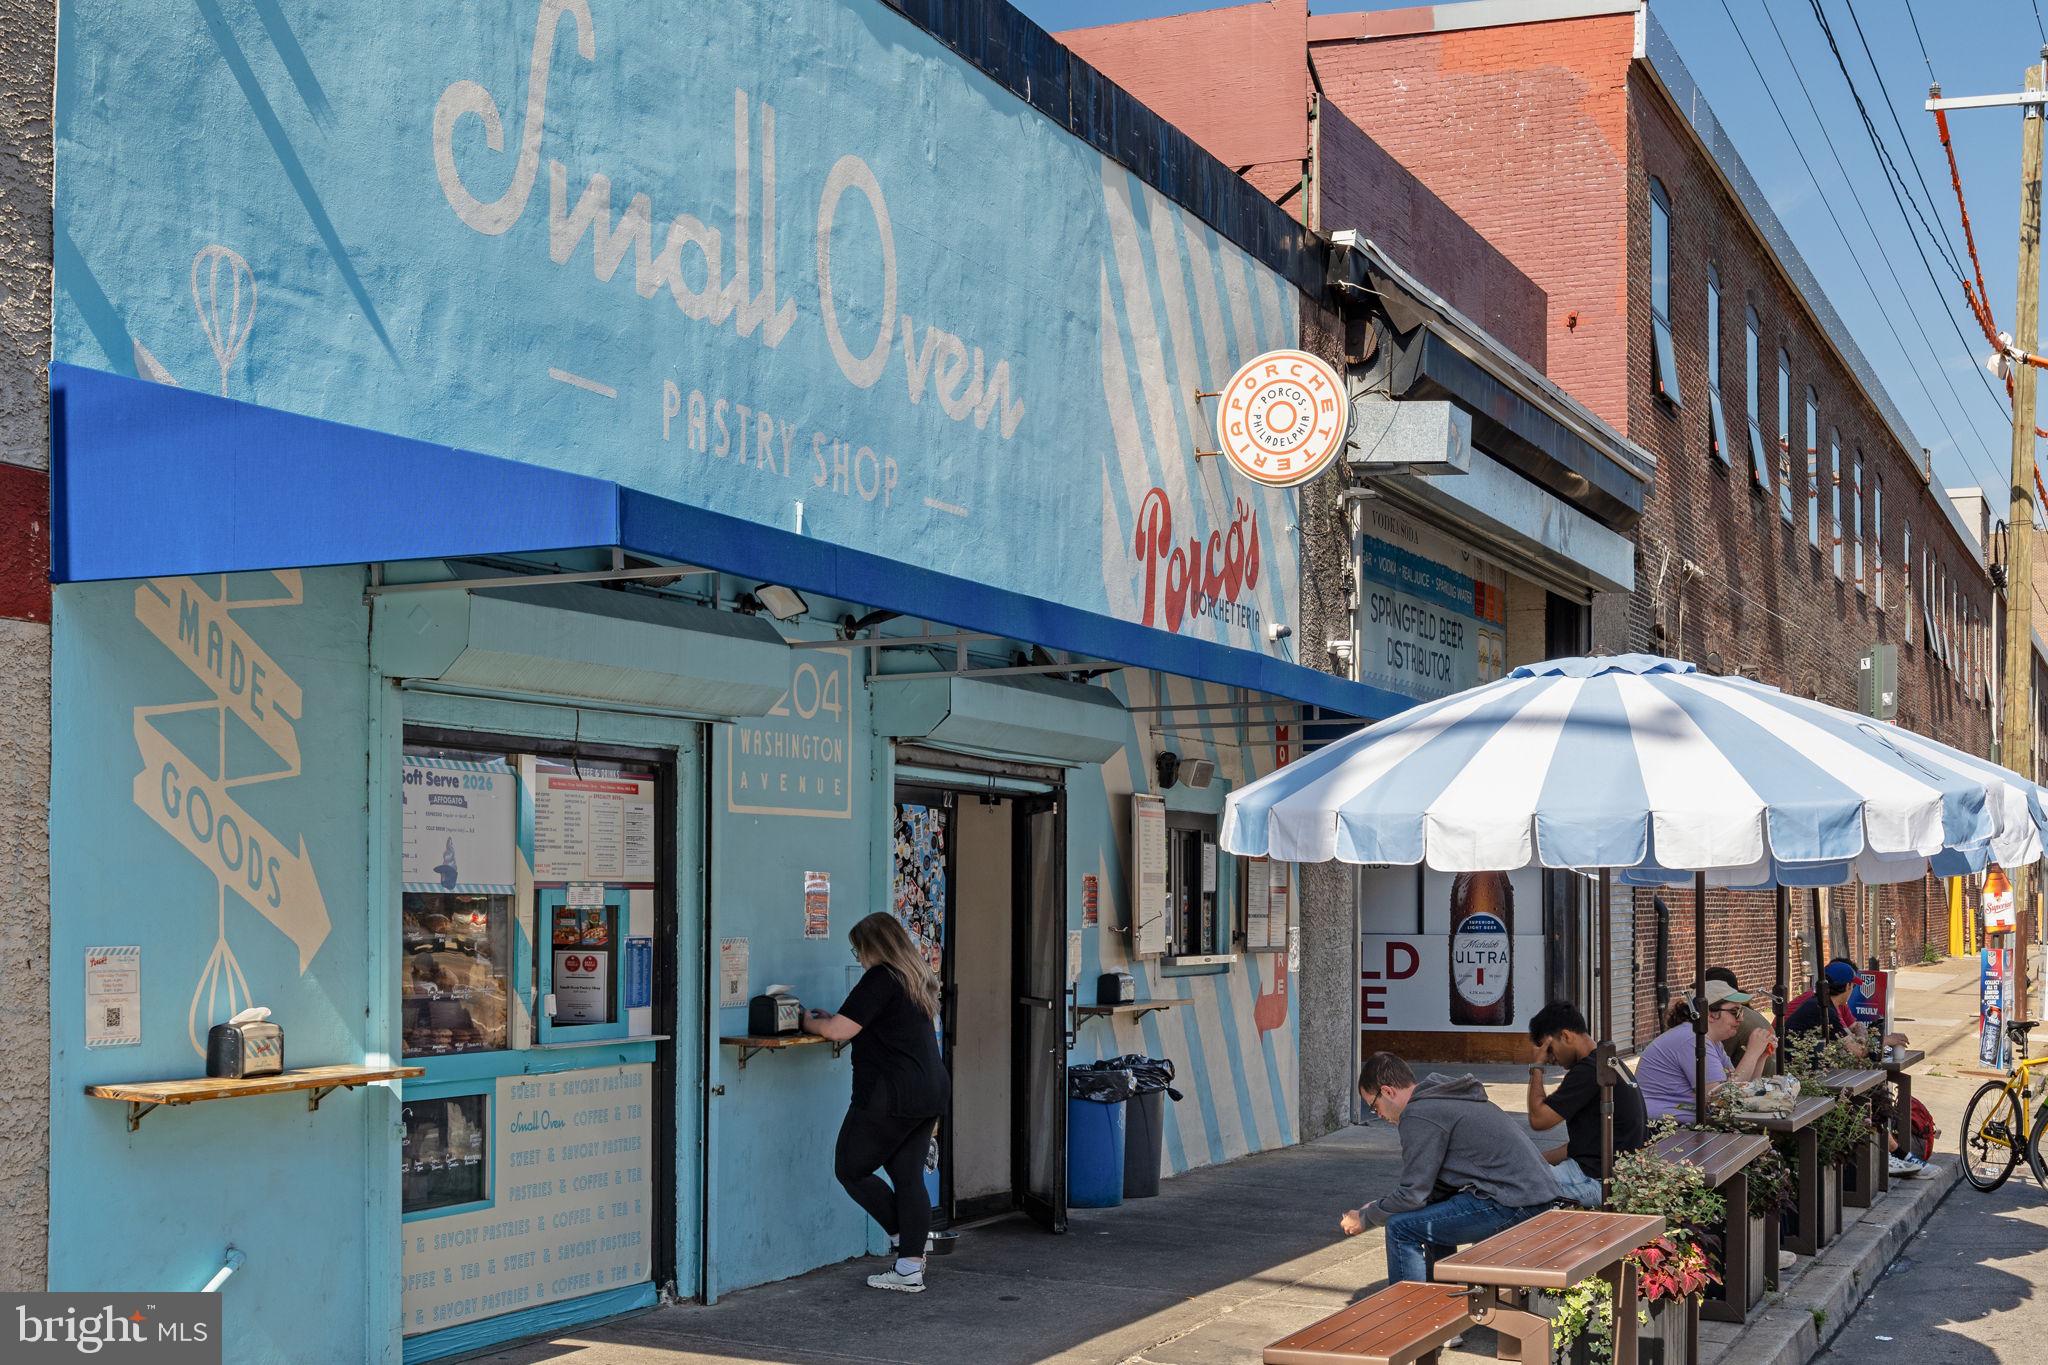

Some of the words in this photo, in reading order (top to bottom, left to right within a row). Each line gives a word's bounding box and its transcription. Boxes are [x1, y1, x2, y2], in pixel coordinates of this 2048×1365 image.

[433, 0, 797, 348] Small
[818, 154, 1025, 440] Oven
[1260, 387, 1307, 406] PORCOS
[662, 379, 798, 479] PASTRY
[812, 430, 899, 508] SHOP
[1253, 414, 1310, 447] PHILADELPHIA
[1135, 487, 1260, 634] Porco's
[1378, 556, 1396, 576] VODKA
[1440, 616, 1464, 651] BEER
[178, 587, 266, 722] MADE
[740, 728, 842, 763] WASHINGTON
[426, 770, 460, 788] Serve
[462, 774, 494, 792] 2026
[570, 766, 593, 777] CFFEE
[740, 771, 841, 795] AVENUE
[433, 794, 463, 805] AFFOGATO
[944, 791, 953, 808] 22
[161, 761, 281, 909] GOODS
[1456, 950, 1508, 964] ULTRA
[1462, 940, 1500, 949] Michelob
[1856, 1006, 1878, 1016] TRULY
[510, 1083, 542, 1100] SWEET
[550, 1082, 556, 1096] &
[563, 1078, 600, 1095] SAVORY
[602, 1073, 643, 1090] PASTRIES
[510, 1112, 540, 1134] Small
[540, 1110, 566, 1130] Oven
[574, 1108, 609, 1126] COFFEE
[614, 1106, 621, 1120] &
[627, 1104, 642, 1118] TEA
[510, 1151, 540, 1168] SWEET
[548, 1148, 555, 1162] &
[562, 1142, 600, 1160] SAVORY
[602, 1136, 642, 1154] PASTRIES
[510, 1181, 553, 1202] PASTRIES
[573, 1172, 608, 1192] COFFEE
[614, 1170, 621, 1184] &
[627, 1168, 642, 1182] TEA
[416, 1238, 424, 1253] &
[434, 1228, 478, 1250] SAVORY
[482, 1218, 530, 1242] PASTRIES
[538, 1216, 544, 1232] &
[552, 1207, 591, 1228] COFFEE
[598, 1206, 604, 1220] &
[611, 1202, 628, 1218] TEA
[444, 1268, 452, 1284] &
[461, 1262, 480, 1281] TEA
[488, 1258, 496, 1274] &
[504, 1251, 536, 1272] SWEET
[544, 1249, 550, 1263] &
[558, 1238, 597, 1261] SAVORY
[600, 1230, 642, 1250] PASTRIES
[416, 1309, 424, 1326] &
[434, 1299, 477, 1322] SAVORY
[482, 1286, 529, 1313] PASTRIES
[536, 1282, 544, 1298] &
[552, 1272, 590, 1296] COFFEE
[611, 1265, 628, 1280] TEA
